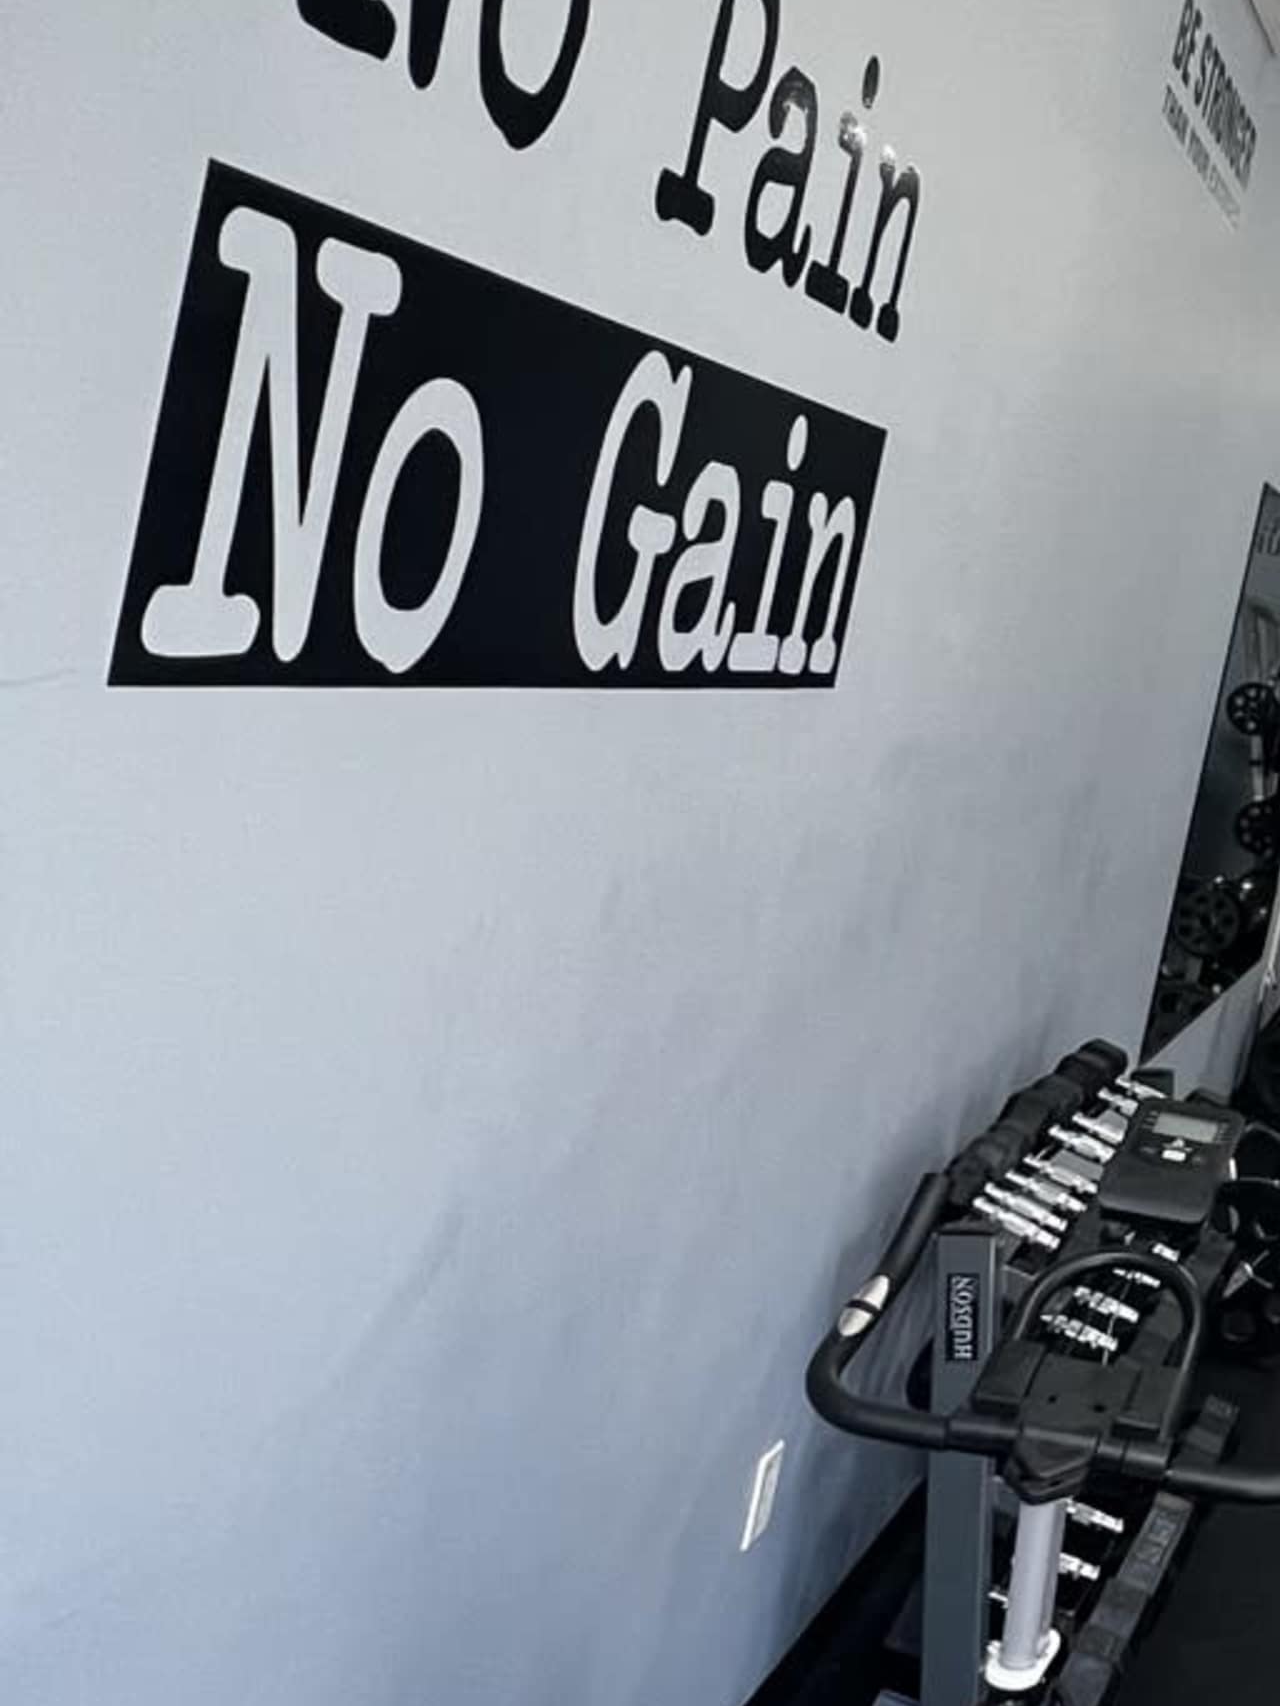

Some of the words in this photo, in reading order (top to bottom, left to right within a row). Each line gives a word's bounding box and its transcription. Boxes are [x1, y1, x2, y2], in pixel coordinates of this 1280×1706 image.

[140, 205, 484, 674] No
[572, 349, 856, 676] Gain
[951, 1275, 976, 1359] HUDSON
